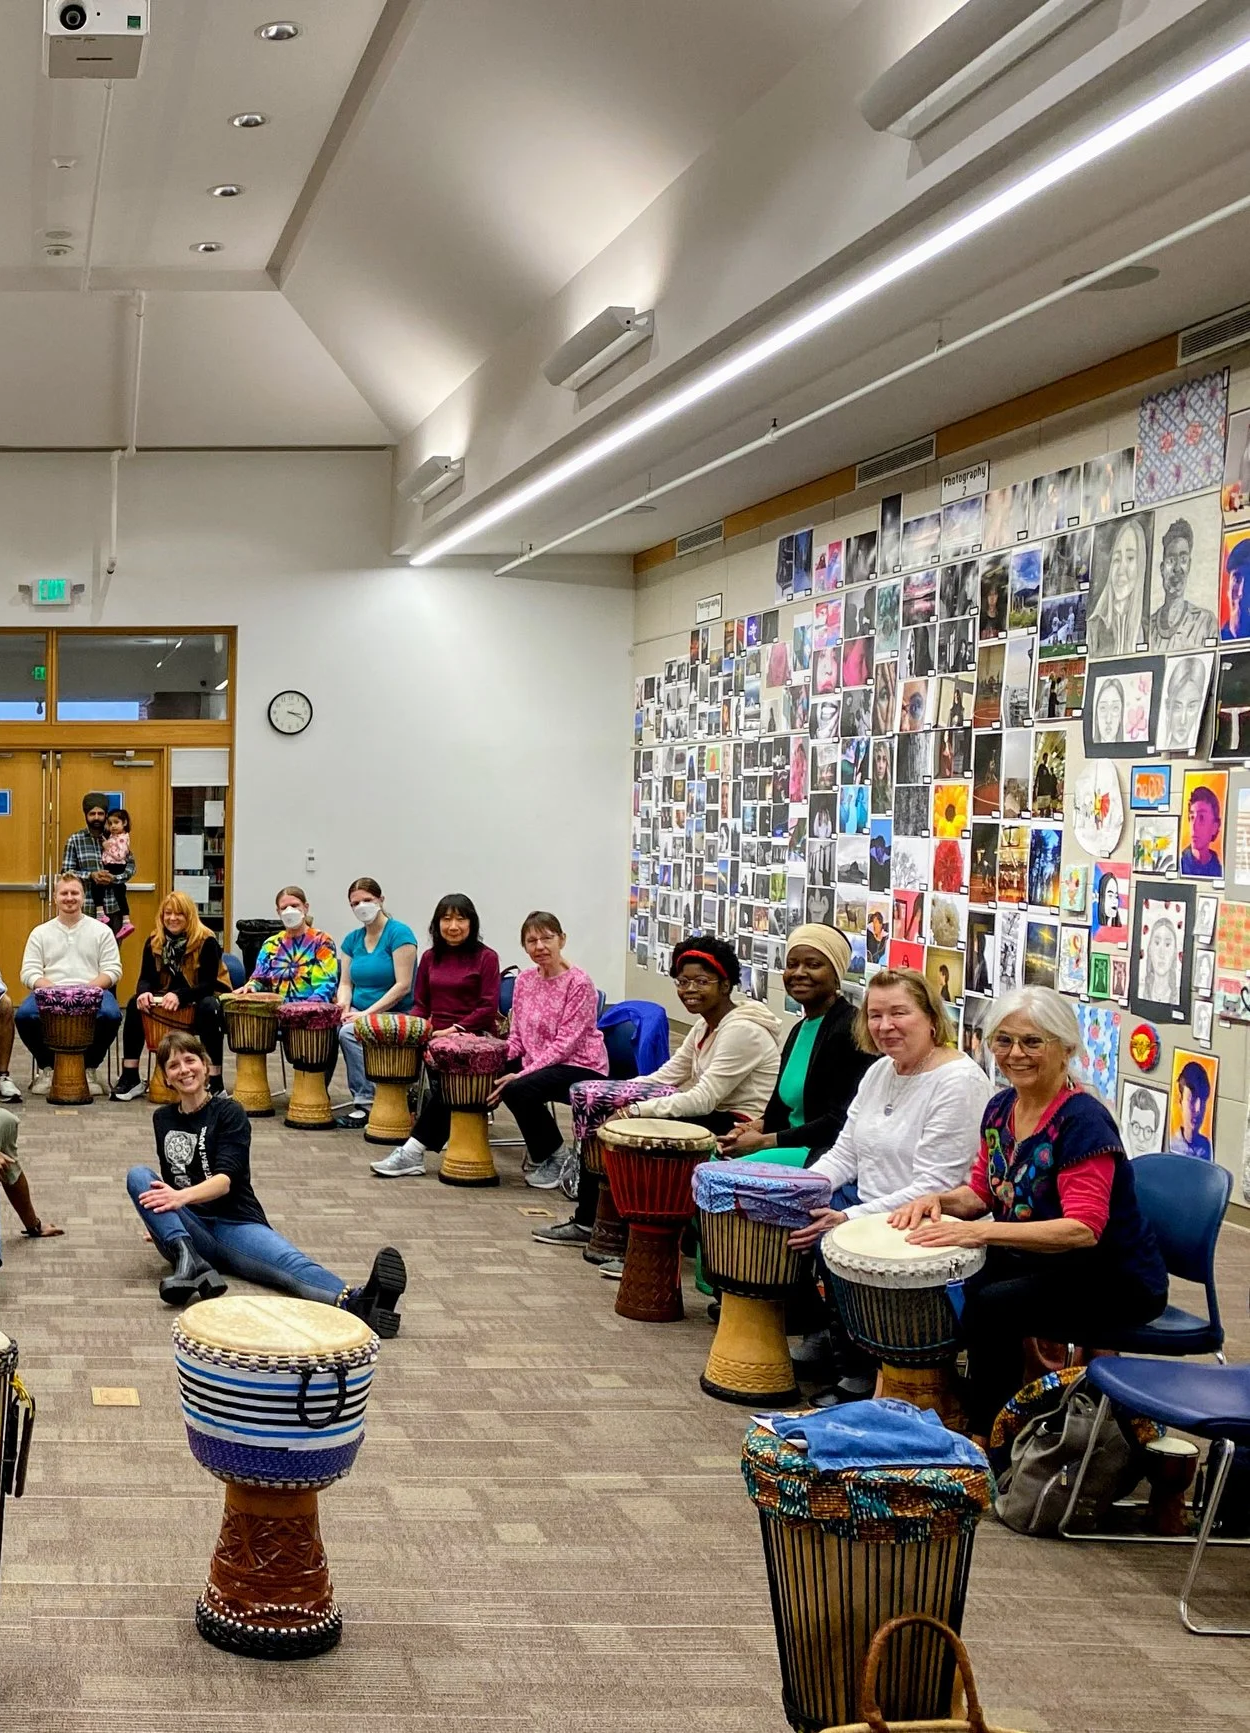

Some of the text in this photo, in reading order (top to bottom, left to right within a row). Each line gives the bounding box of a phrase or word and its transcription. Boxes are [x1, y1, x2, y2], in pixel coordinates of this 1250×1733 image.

[943, 466, 986, 487] Photography
[962, 486, 966, 496] 2
[38, 579, 66, 600] EXIT
